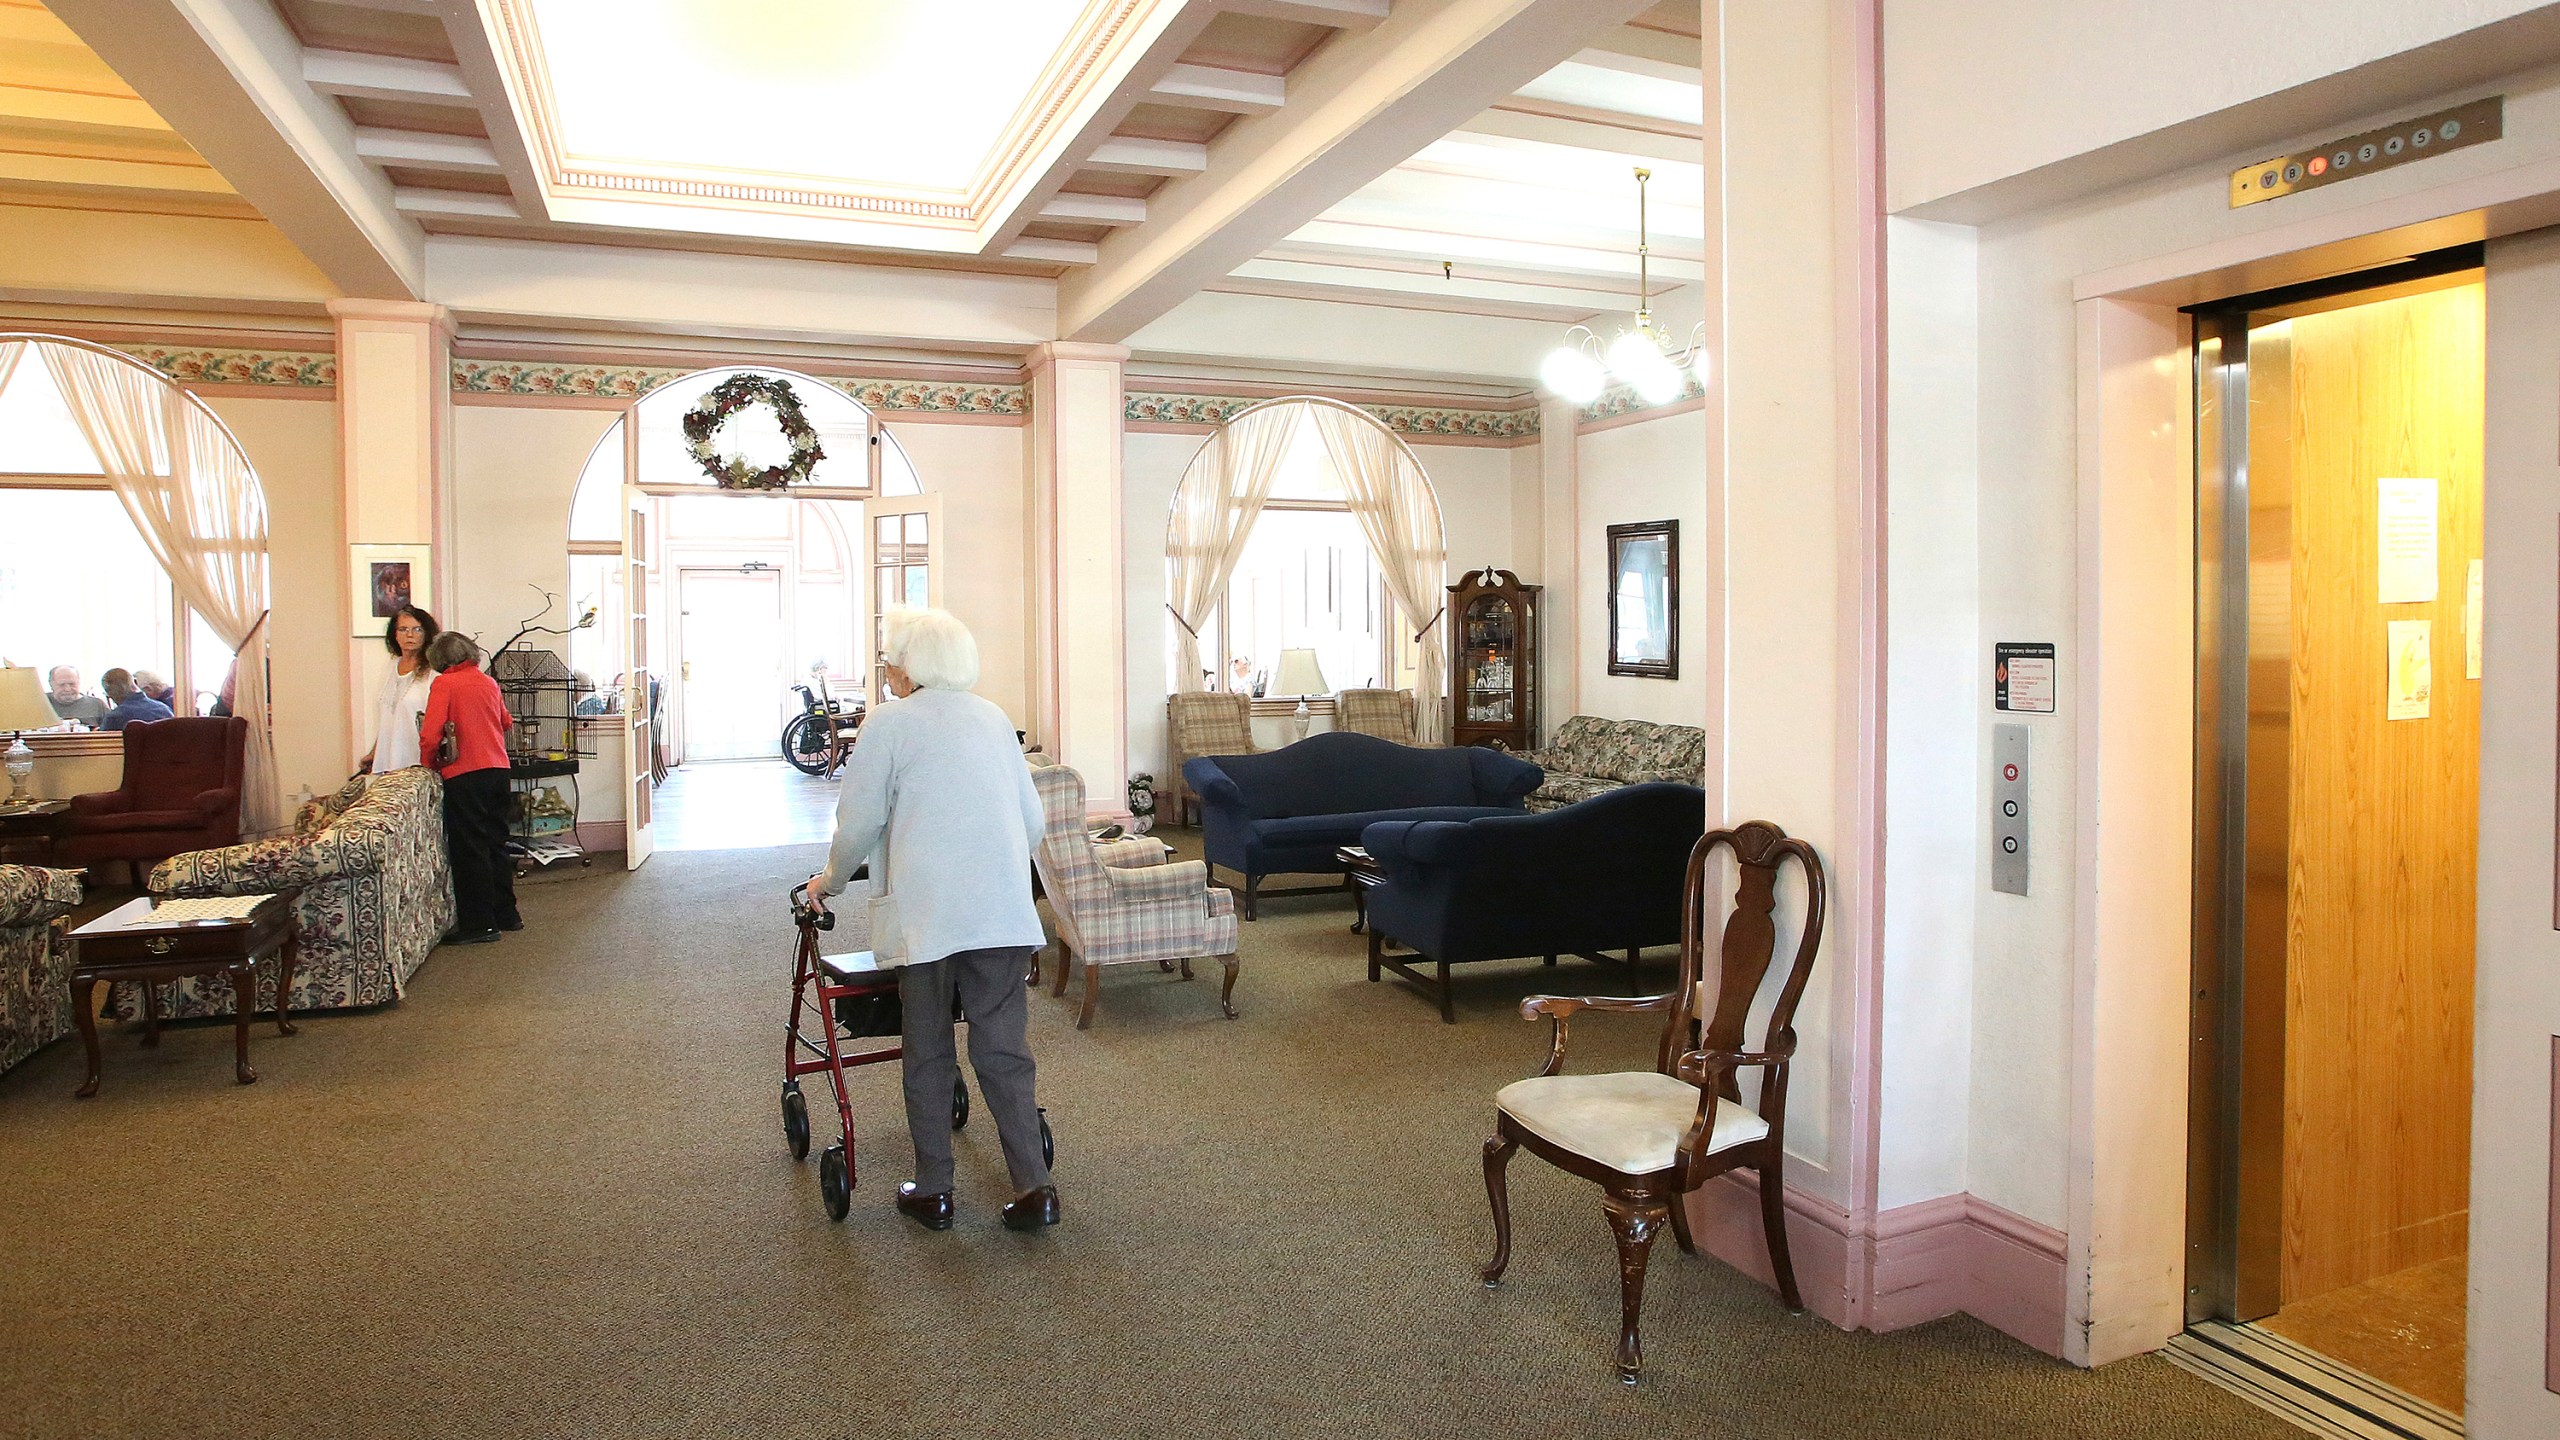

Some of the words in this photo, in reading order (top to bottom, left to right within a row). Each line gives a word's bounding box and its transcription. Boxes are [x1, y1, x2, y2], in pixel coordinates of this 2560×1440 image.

[2289, 168, 2296, 178] B
[2313, 162, 2320, 172] L
[2338, 155, 2346, 165] 2
[2364, 148, 2371, 158] 3
[2389, 140, 2397, 150] 4
[2417, 132, 2426, 143] 5
